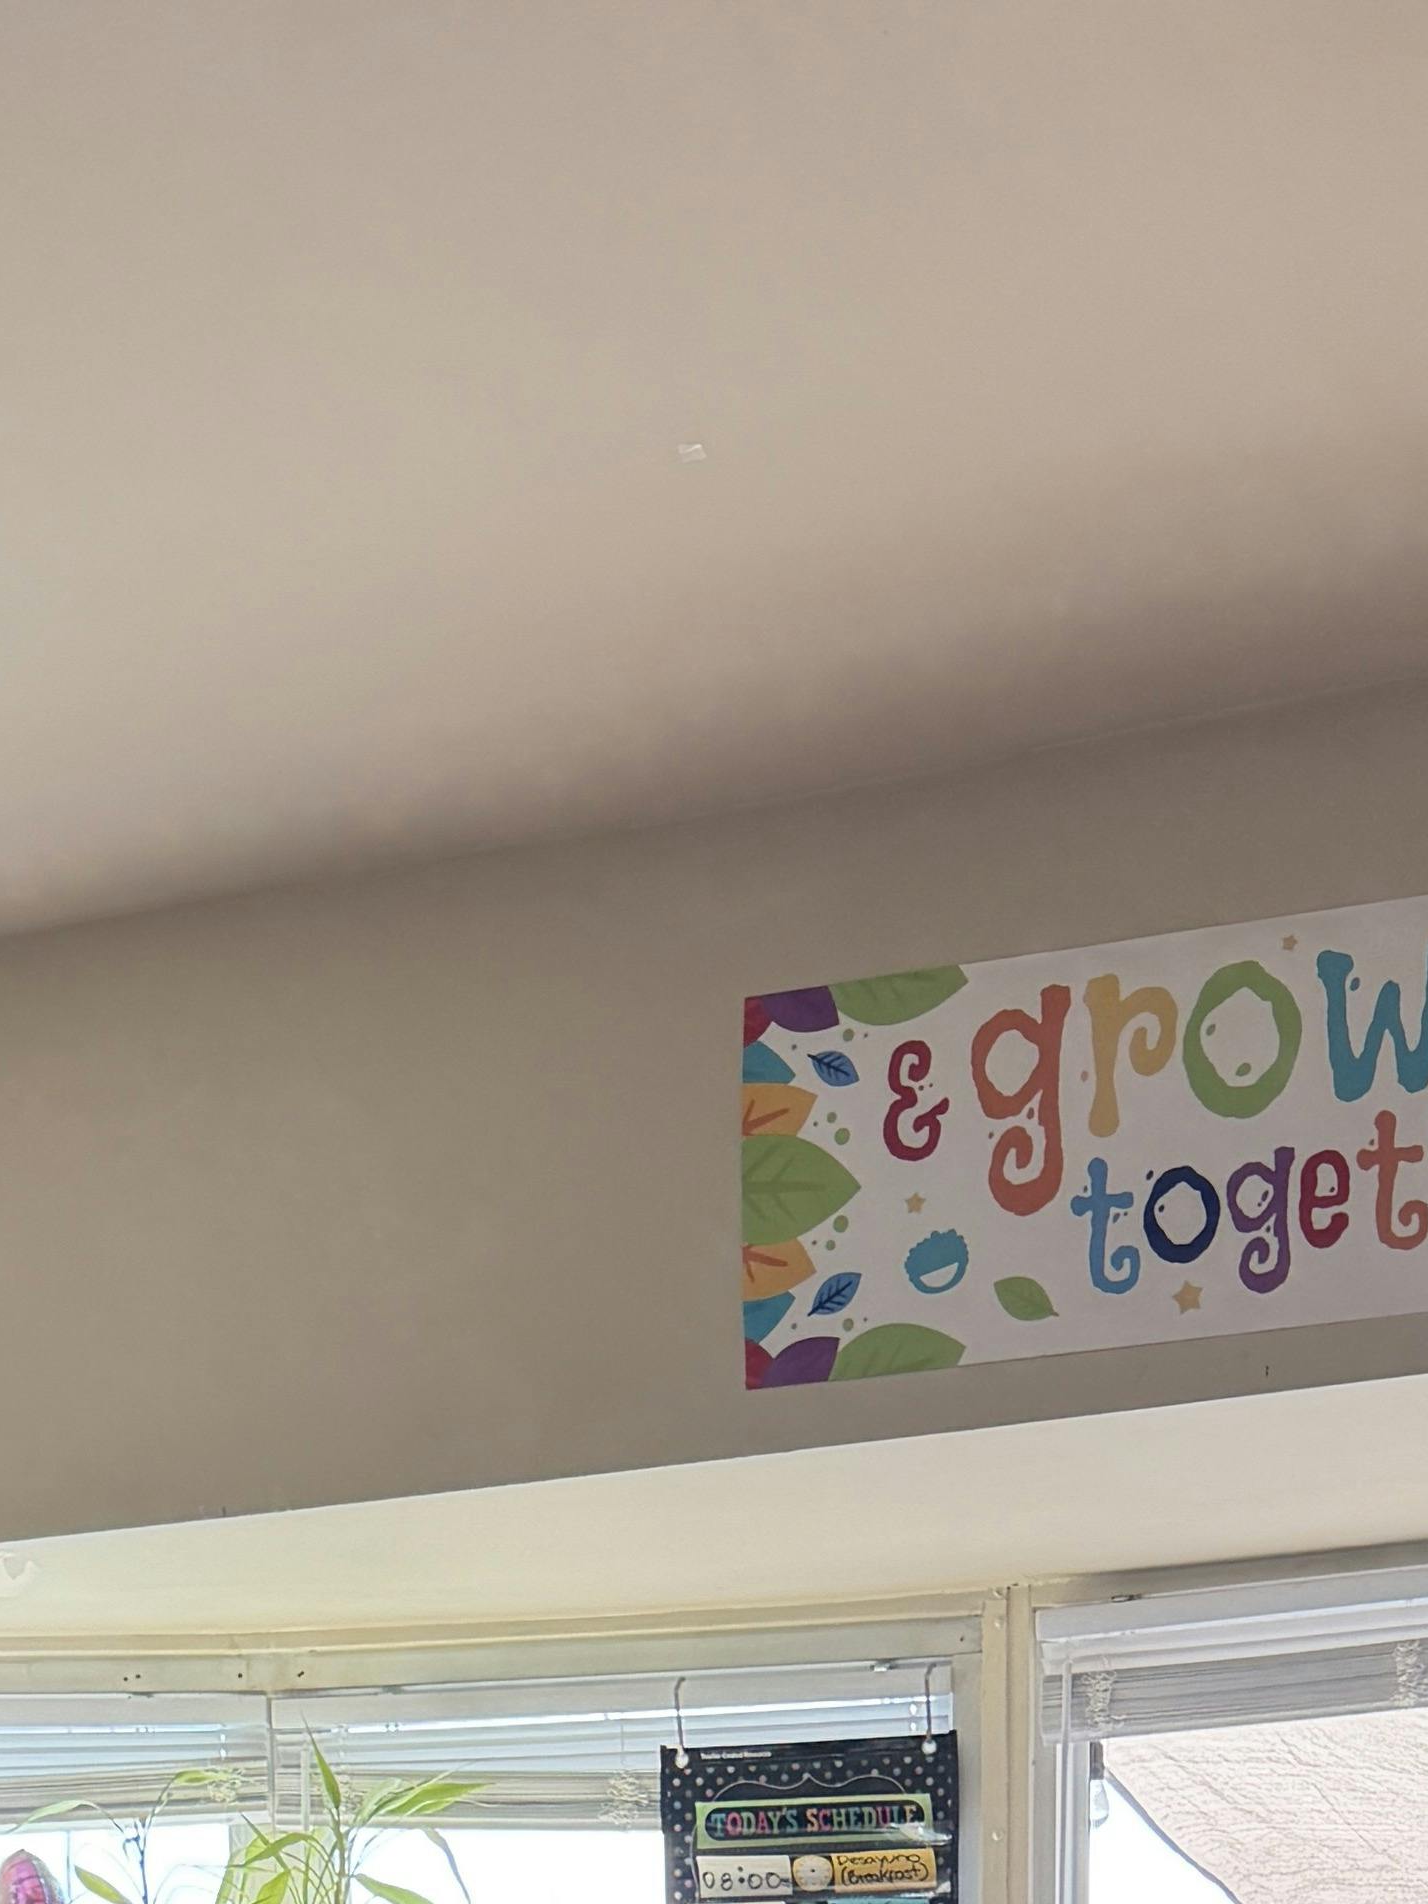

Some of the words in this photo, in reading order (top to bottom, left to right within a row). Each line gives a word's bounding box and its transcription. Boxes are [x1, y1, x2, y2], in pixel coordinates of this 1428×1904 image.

[883, 1040, 948, 1162] &
[711, 1807, 798, 1835] TODAY'S
[806, 1804, 917, 1833] SCHEDULE
[837, 1854, 921, 1876] Desayuno
